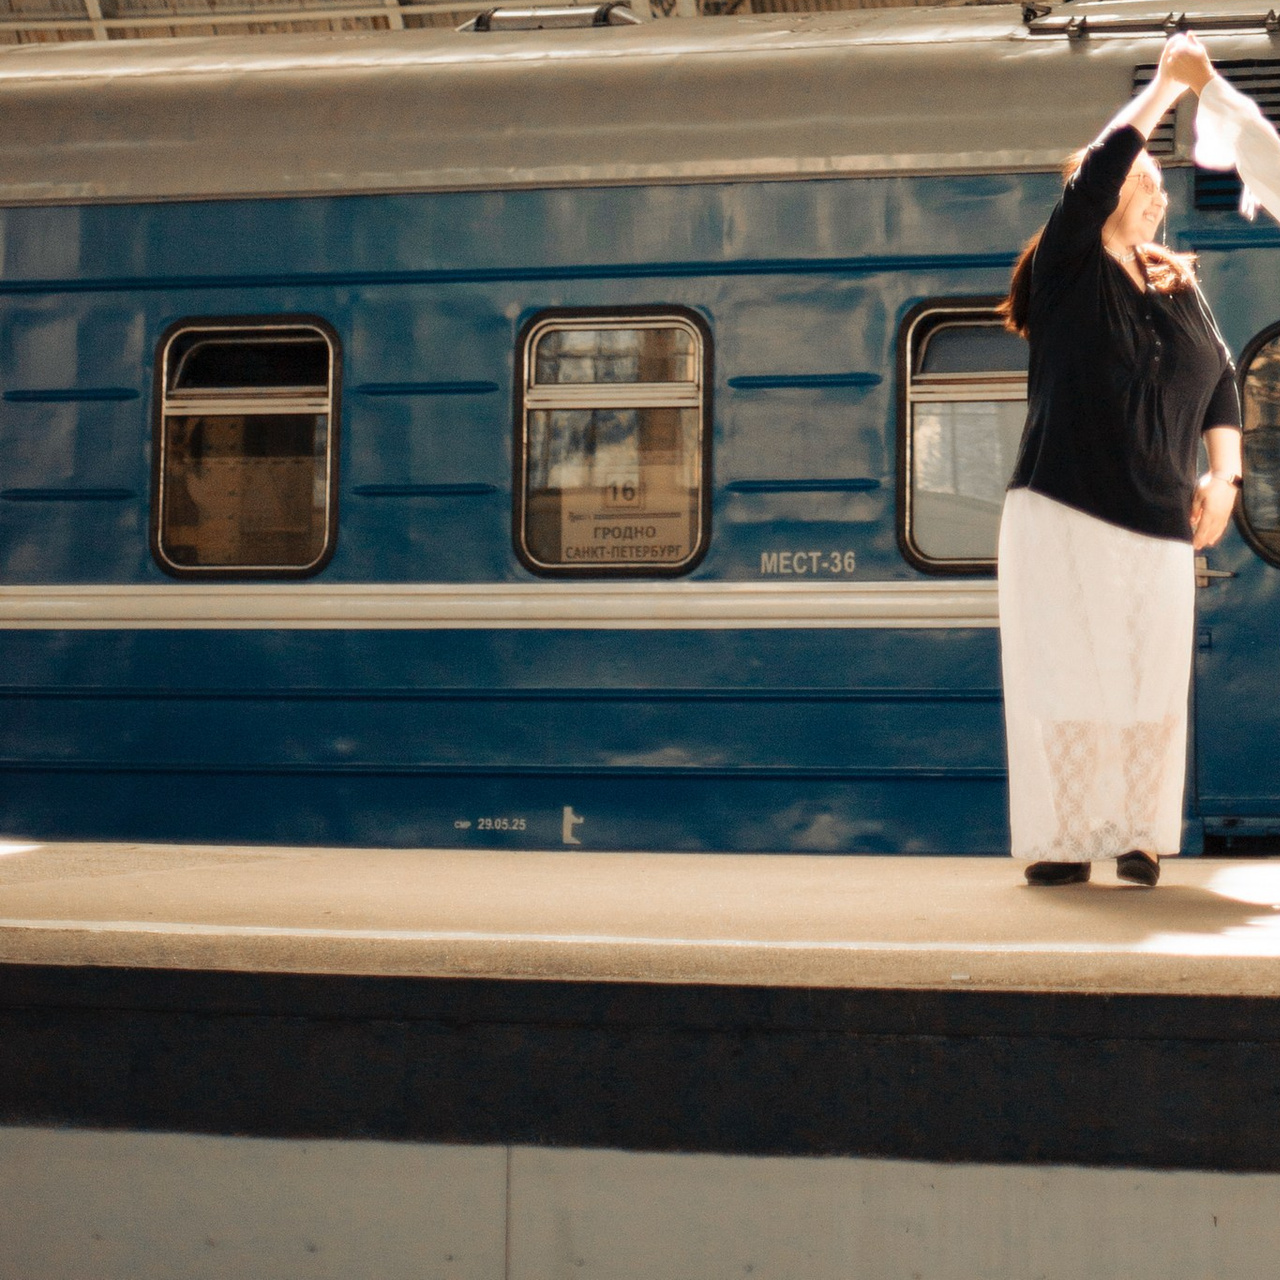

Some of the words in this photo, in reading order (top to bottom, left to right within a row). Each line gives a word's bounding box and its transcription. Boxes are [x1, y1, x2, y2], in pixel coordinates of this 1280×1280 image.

[610, 481, 636, 502] 16
[593, 526, 656, 539] ГРОДНО
[565, 545, 682, 559] САНКТ-ПЕТЕРБУРГ
[761, 551, 856, 574] МЕСТ-36
[477, 818, 527, 831] 29.05.25
